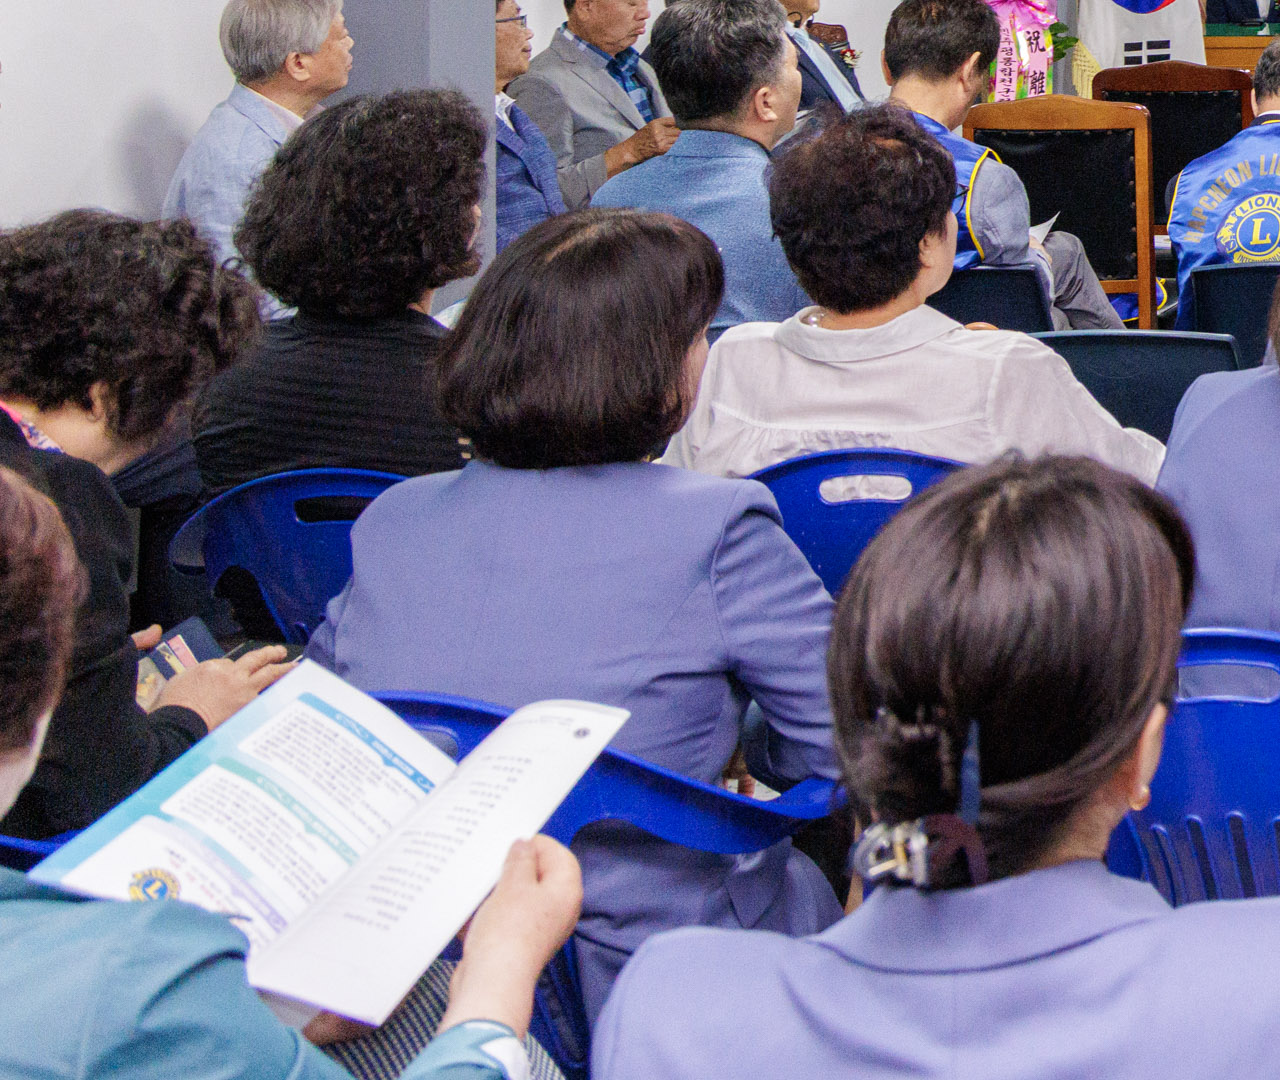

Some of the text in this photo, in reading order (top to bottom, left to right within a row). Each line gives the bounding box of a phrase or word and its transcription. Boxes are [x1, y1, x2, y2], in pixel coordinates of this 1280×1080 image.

[1024, 30, 1046, 53] 祝
[1184, 160, 1253, 243] HAPCHEON
[1250, 218, 1271, 245] L
